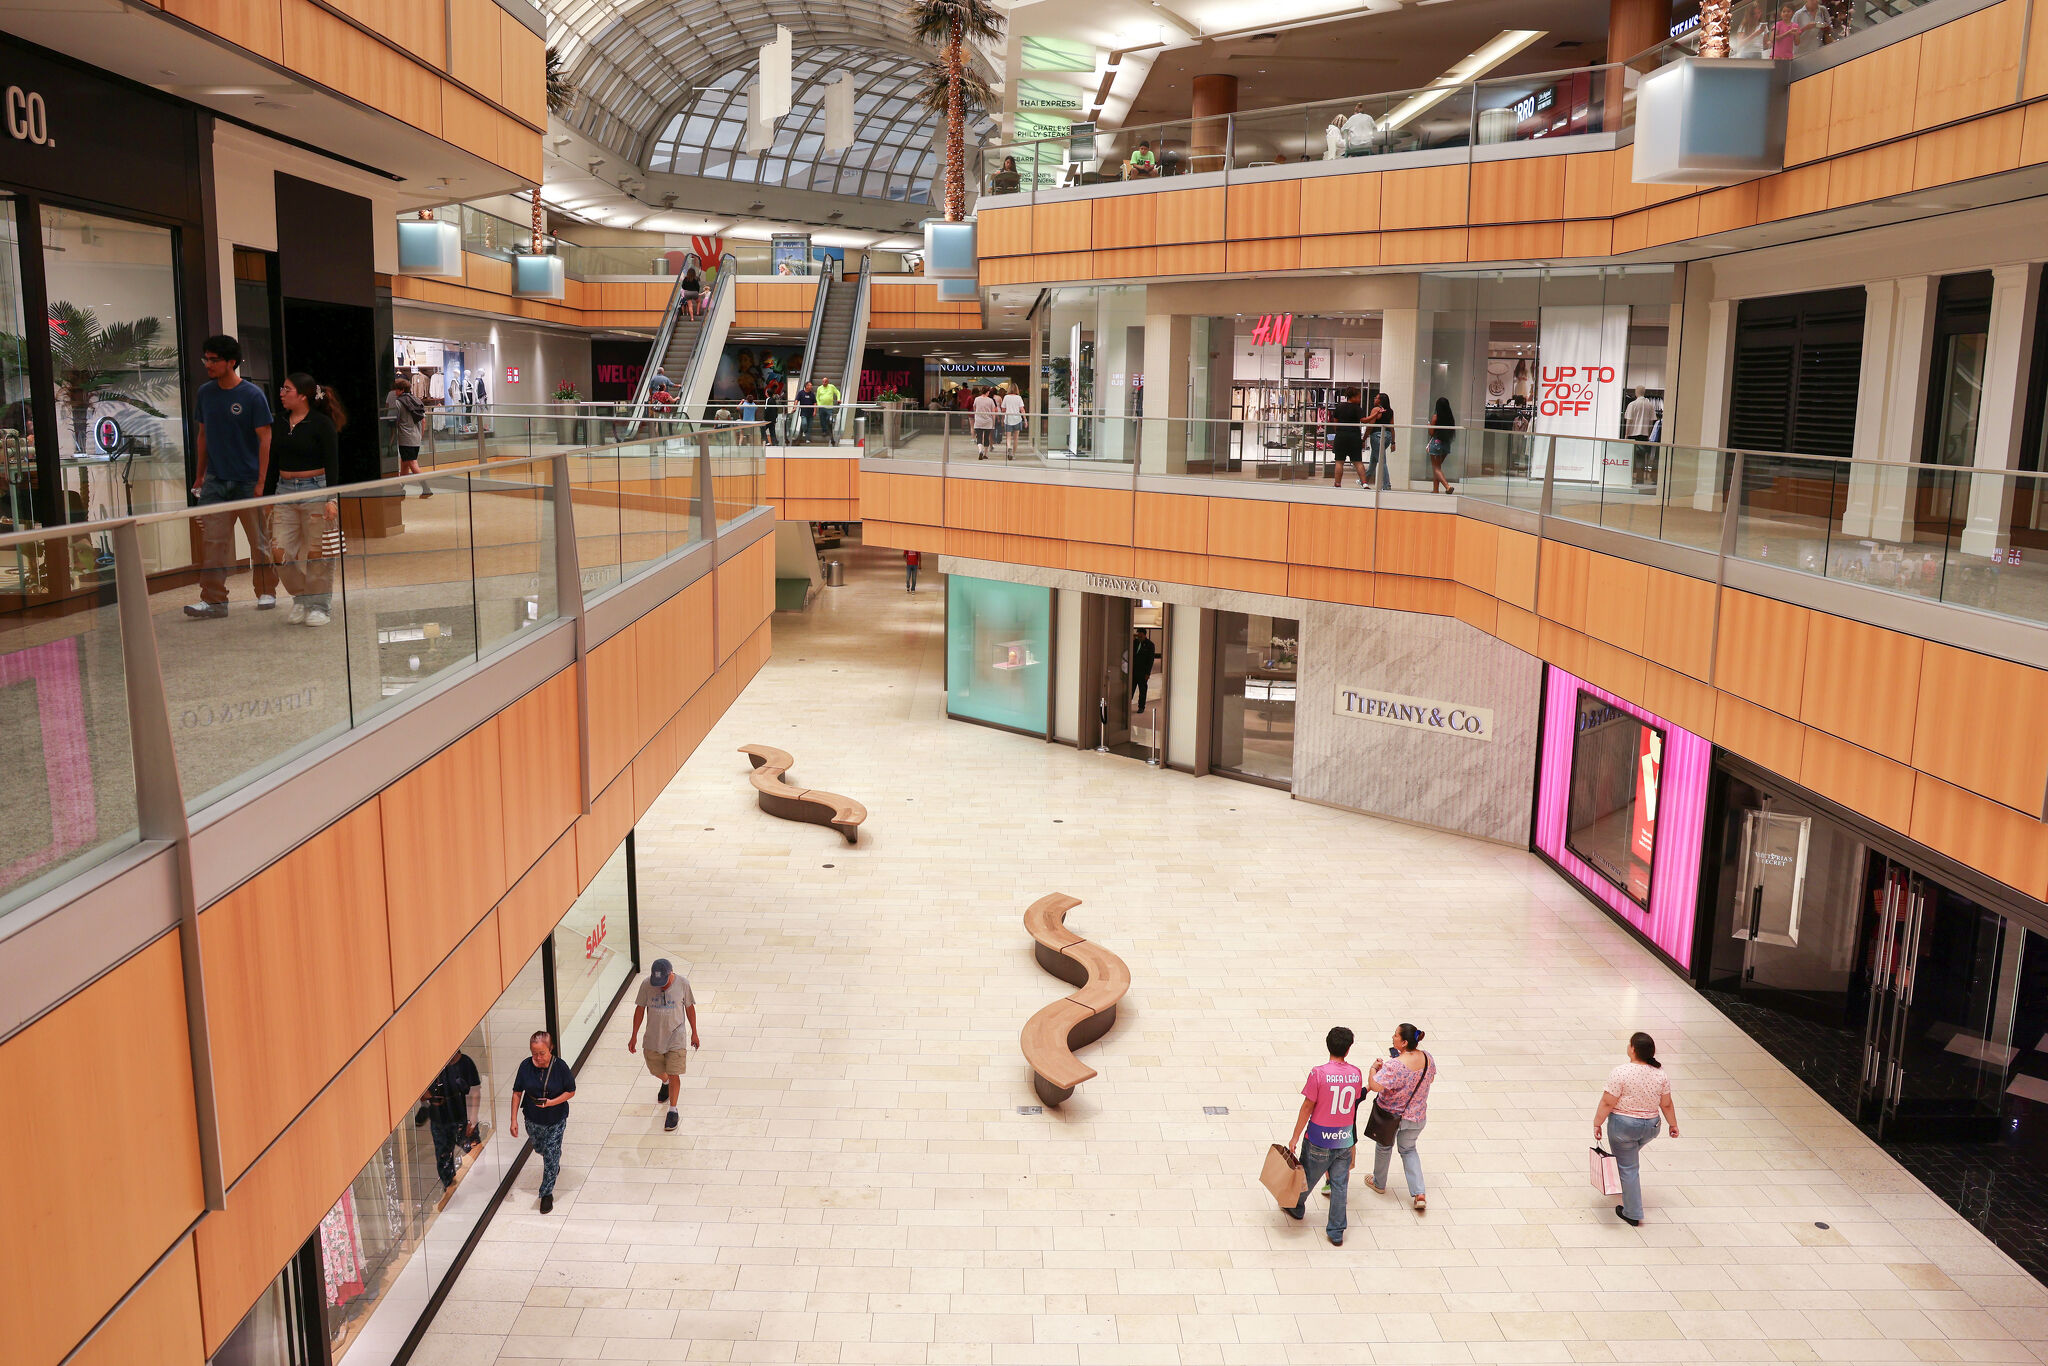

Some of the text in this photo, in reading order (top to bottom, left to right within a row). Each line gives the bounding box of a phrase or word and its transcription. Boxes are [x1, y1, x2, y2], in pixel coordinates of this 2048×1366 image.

[1020, 99, 1076, 108] THAI EXPRESS
[5, 85, 56, 148] CO.
[1251, 314, 1293, 347] H&M
[597, 364, 644, 383] WELCO
[940, 364, 1005, 372] NORDSTROM
[1542, 366, 1615, 383] UP TO
[1541, 383, 1594, 400] 70%
[1540, 400, 1591, 417] OFF
[1602, 458, 1630, 467] SALE
[1084, 573, 1129, 592] TIFFANY
[1129, 580, 1138, 593] &
[1342, 690, 1428, 724] TIFFANY
[1427, 707, 1446, 728] &
[586, 914, 607, 960] SALE
[1326, 1073, 1360, 1083] RAFA LEÃO
[1330, 1085, 1356, 1115] 10
[1321, 1129, 1352, 1140] wefox
